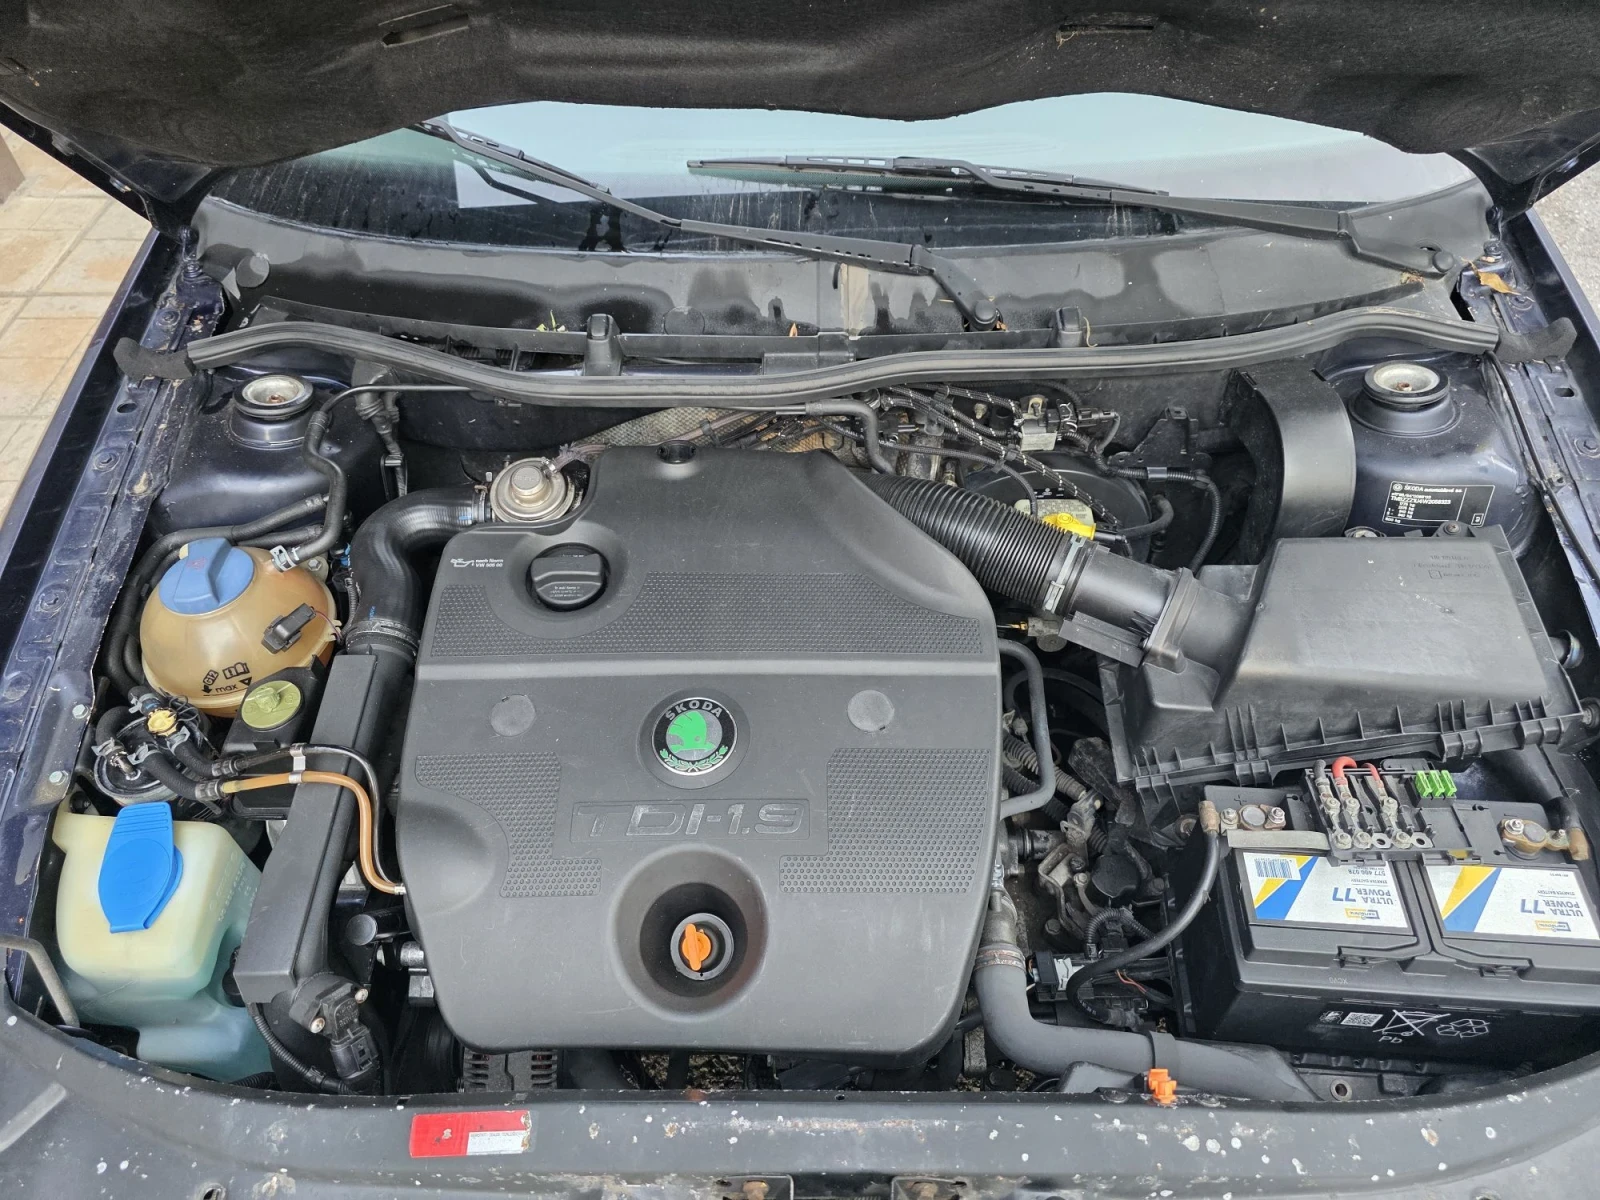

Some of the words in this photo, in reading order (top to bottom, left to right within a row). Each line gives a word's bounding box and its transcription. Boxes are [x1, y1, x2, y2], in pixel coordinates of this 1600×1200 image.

[204, 671, 217, 684] G12
[215, 684, 238, 693] max
[1332, 887, 1357, 902] 77
[1355, 888, 1391, 896] POWER
[1361, 896, 1394, 905] ULTRA
[1542, 900, 1580, 908] POWER
[1520, 899, 1545, 914] 77
[1549, 908, 1584, 917] ULTRA
[1378, 1036, 1403, 1044] Pb
